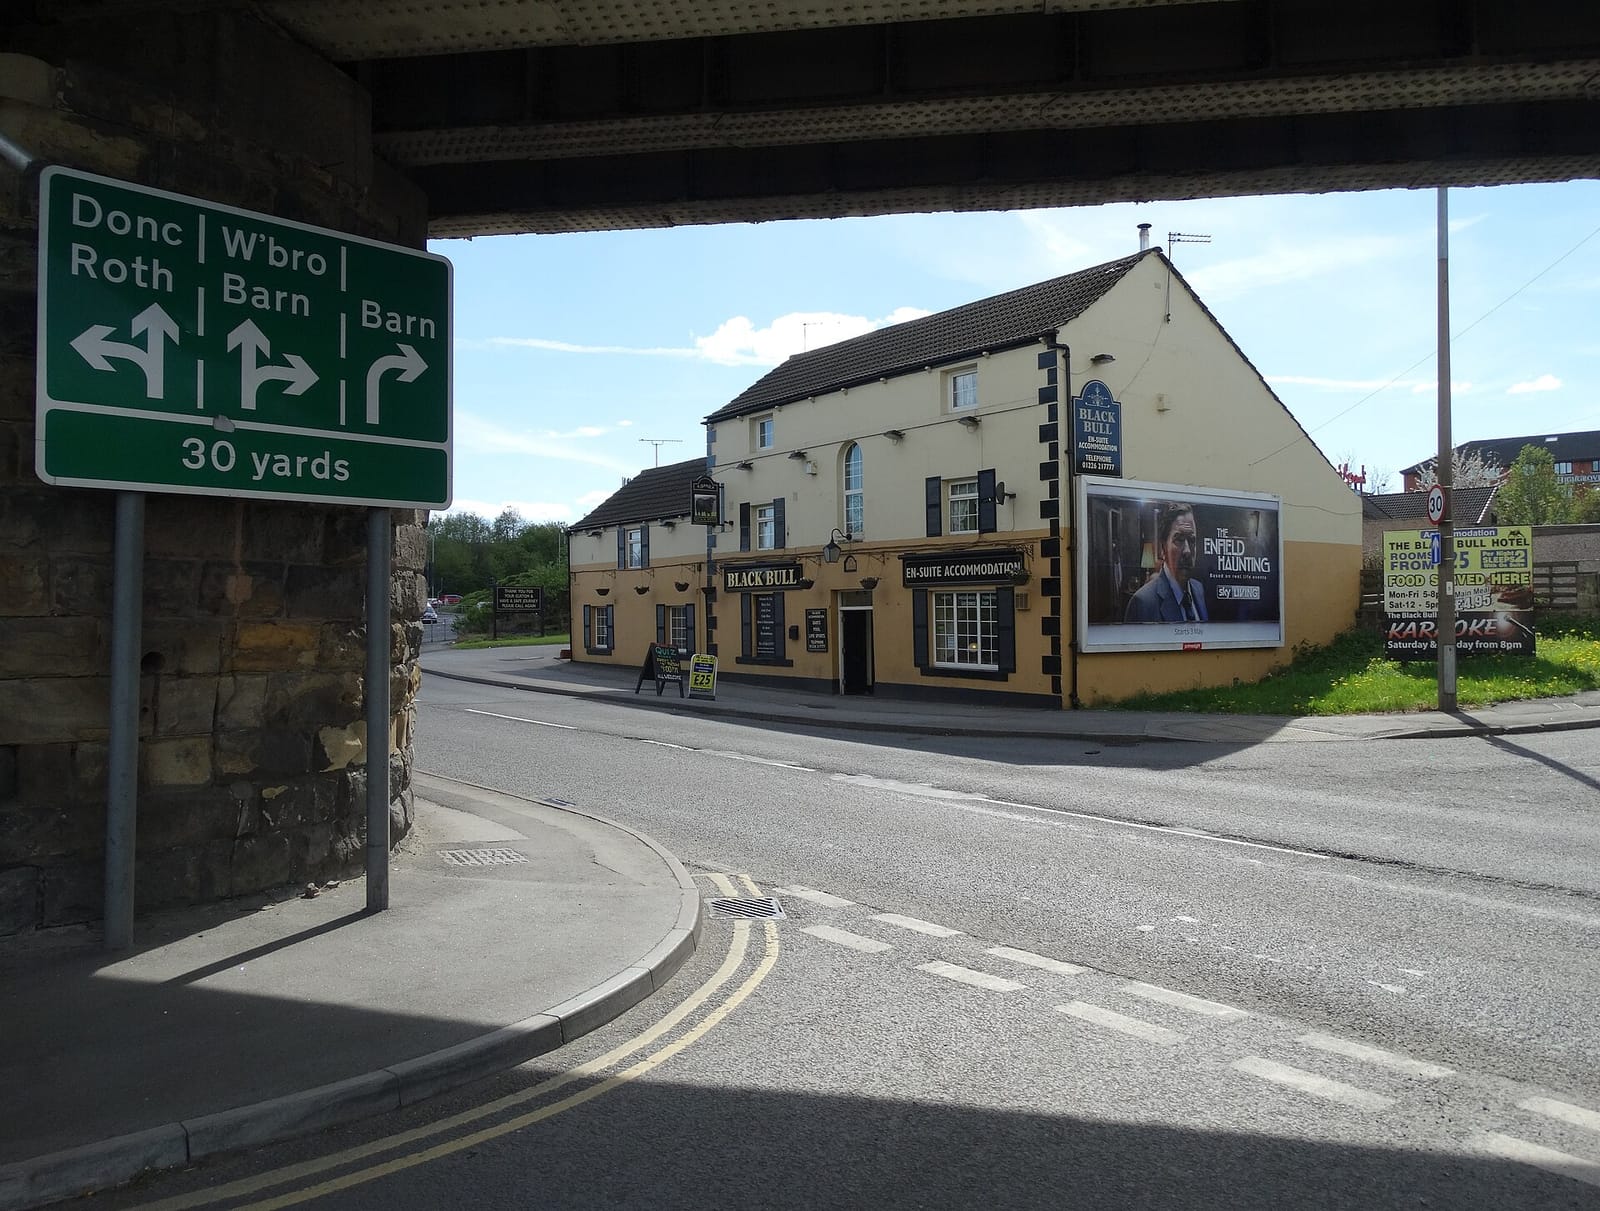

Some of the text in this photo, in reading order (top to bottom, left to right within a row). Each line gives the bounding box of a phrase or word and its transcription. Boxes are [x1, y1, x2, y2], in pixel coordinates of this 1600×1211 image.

[72, 192, 184, 246] Donc
[222, 226, 327, 276] W'bro
[71, 243, 174, 293] Roth
[224, 273, 310, 317] Barn
[361, 299, 437, 339] Barn
[1079, 408, 1116, 424] BLACK
[1084, 420, 1112, 434] BULL
[182, 438, 350, 482] 30 yards
[1085, 454, 1112, 462] TELEPHONE
[1430, 496, 1442, 514] 30
[1217, 528, 1229, 538] THE
[1204, 538, 1245, 556] ENFIELD
[1389, 542, 1410, 550] THE
[1457, 540, 1486, 548] BULL
[1492, 538, 1530, 547] HOTEL
[1218, 556, 1270, 572] HAUNTING
[1515, 550, 1525, 562] 2
[906, 562, 1021, 578] EN-SUITE ACCOMMODATION
[1391, 561, 1434, 570] FROM
[728, 569, 797, 587] BLACK BULL
[1388, 572, 1530, 587] FOOD SVED HERE
[1218, 586, 1258, 598] sky LIVING
[655, 647, 676, 656] QUIZ
[1388, 641, 1428, 650] Saturday
[1500, 642, 1522, 650] 8pm
[694, 675, 711, 685] £25
